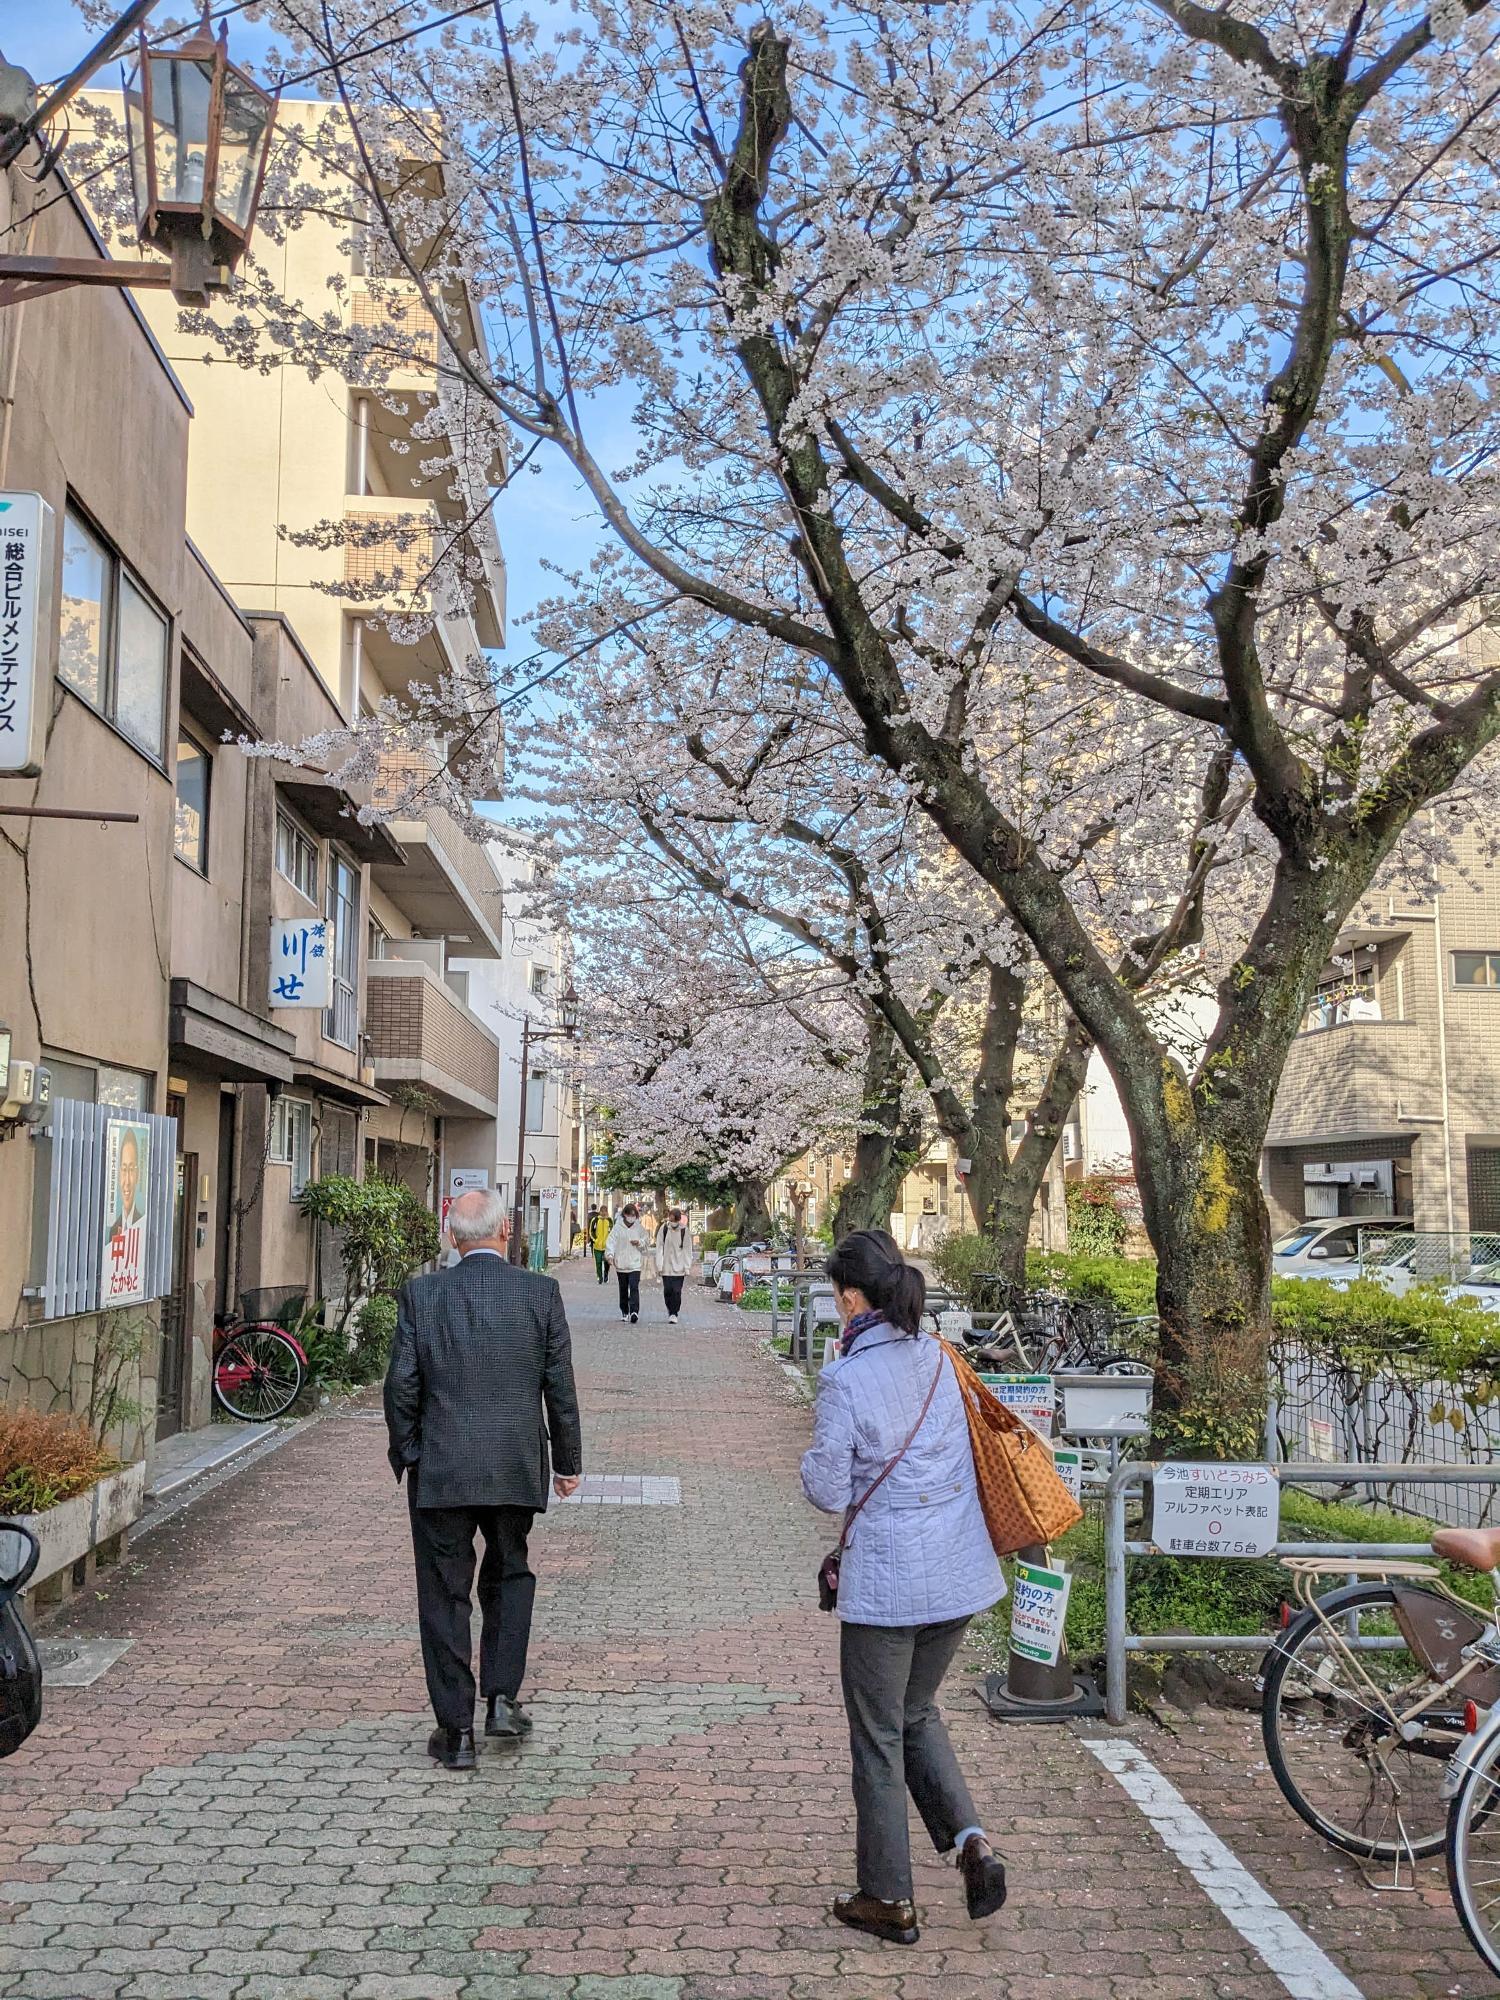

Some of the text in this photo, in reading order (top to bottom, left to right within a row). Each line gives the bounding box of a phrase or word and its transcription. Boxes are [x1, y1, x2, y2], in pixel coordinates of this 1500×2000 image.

[0, 541, 25, 733] 総合ビルメンテナンス
[272, 927, 310, 1001] 川せ
[111, 1227, 140, 1274] 中川
[110, 1269, 139, 1294] たかもと
[1163, 1466, 1268, 1485] 今池すいどうみち
[1185, 1486, 1248, 1501] 定期エリア
[1165, 1501, 1268, 1518] アルファベット表記
